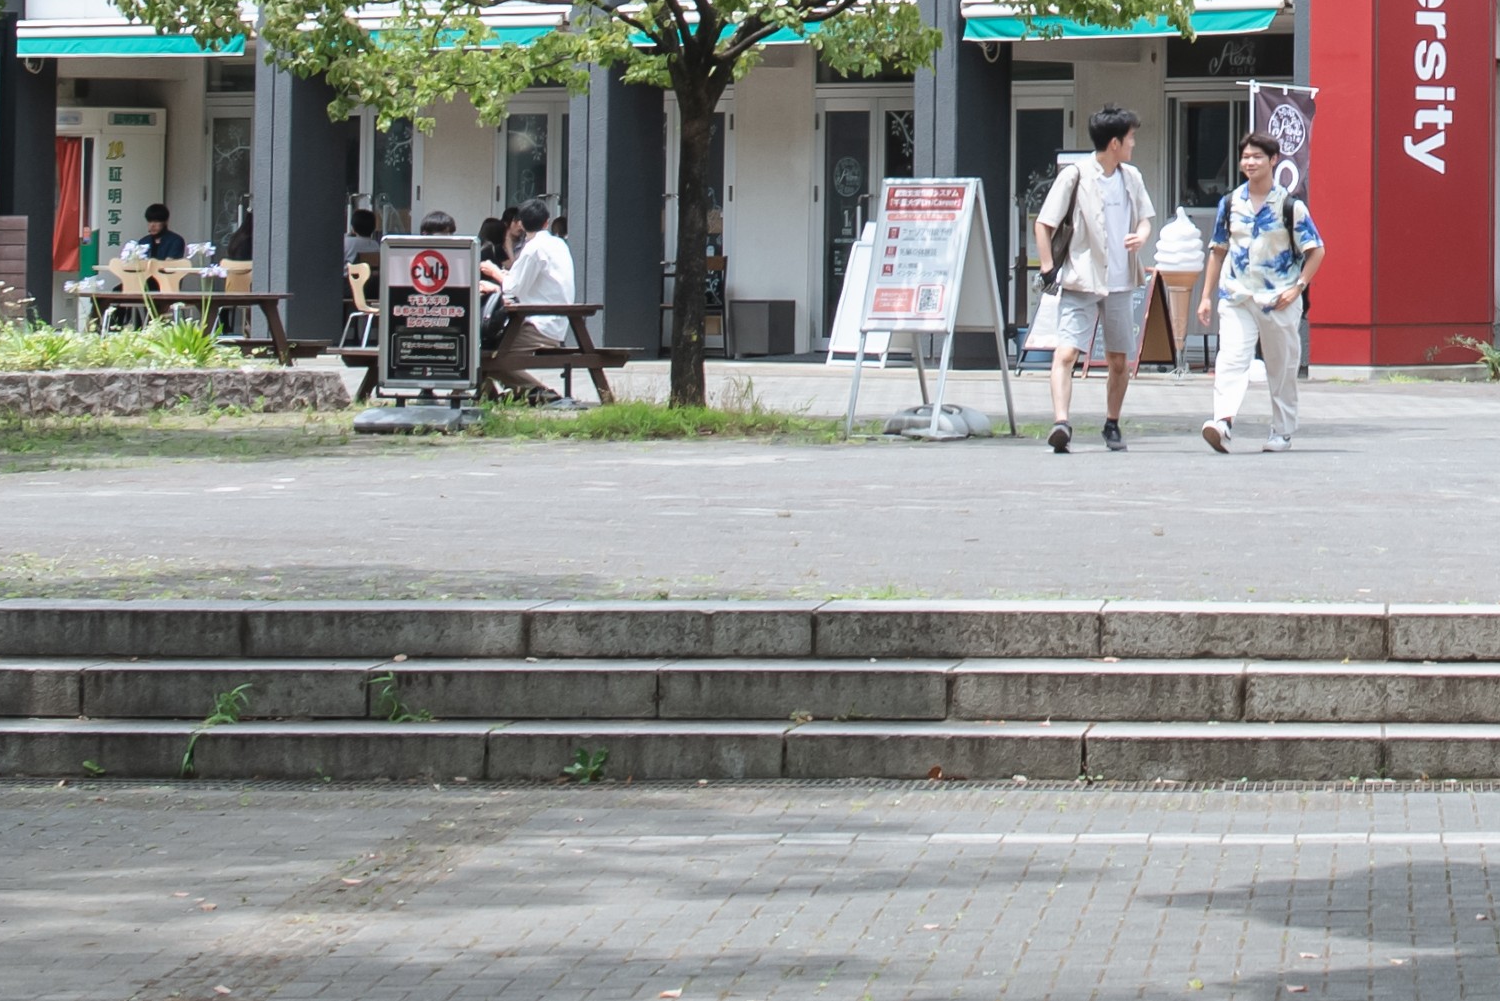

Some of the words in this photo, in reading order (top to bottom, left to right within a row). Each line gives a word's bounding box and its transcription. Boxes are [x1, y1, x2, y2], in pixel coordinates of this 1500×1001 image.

[107, 166, 122, 247] 証明写真
[411, 262, 448, 281] cult
